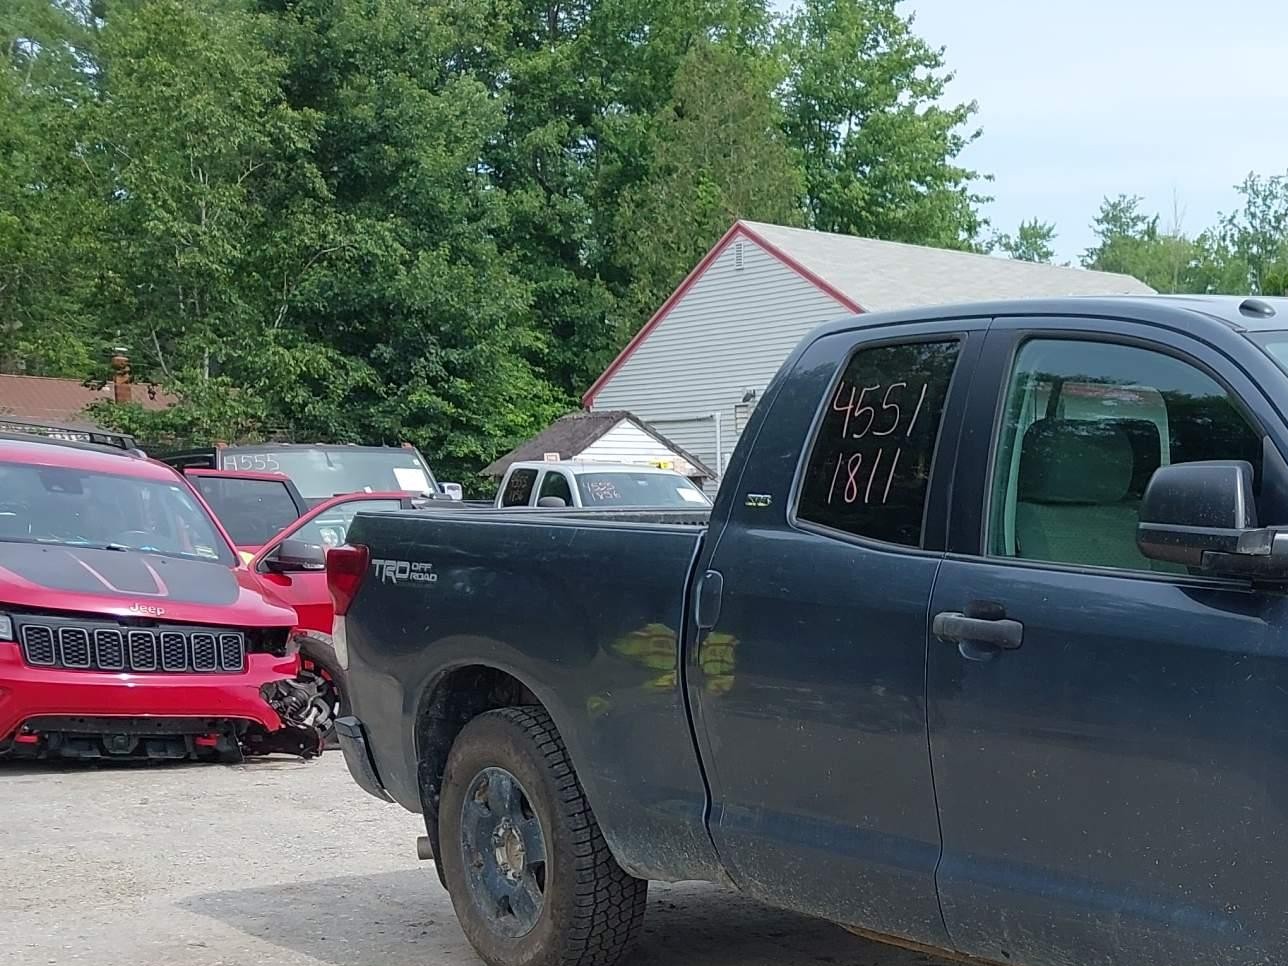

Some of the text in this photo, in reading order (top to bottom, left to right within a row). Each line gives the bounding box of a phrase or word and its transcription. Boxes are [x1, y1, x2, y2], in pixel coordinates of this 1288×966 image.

[833, 382, 927, 439] 4551
[827, 448, 901, 504] 1811
[371, 559, 433, 585] TRD OFF
[409, 572, 438, 582] ROAD
[130, 602, 166, 616] Jeep
